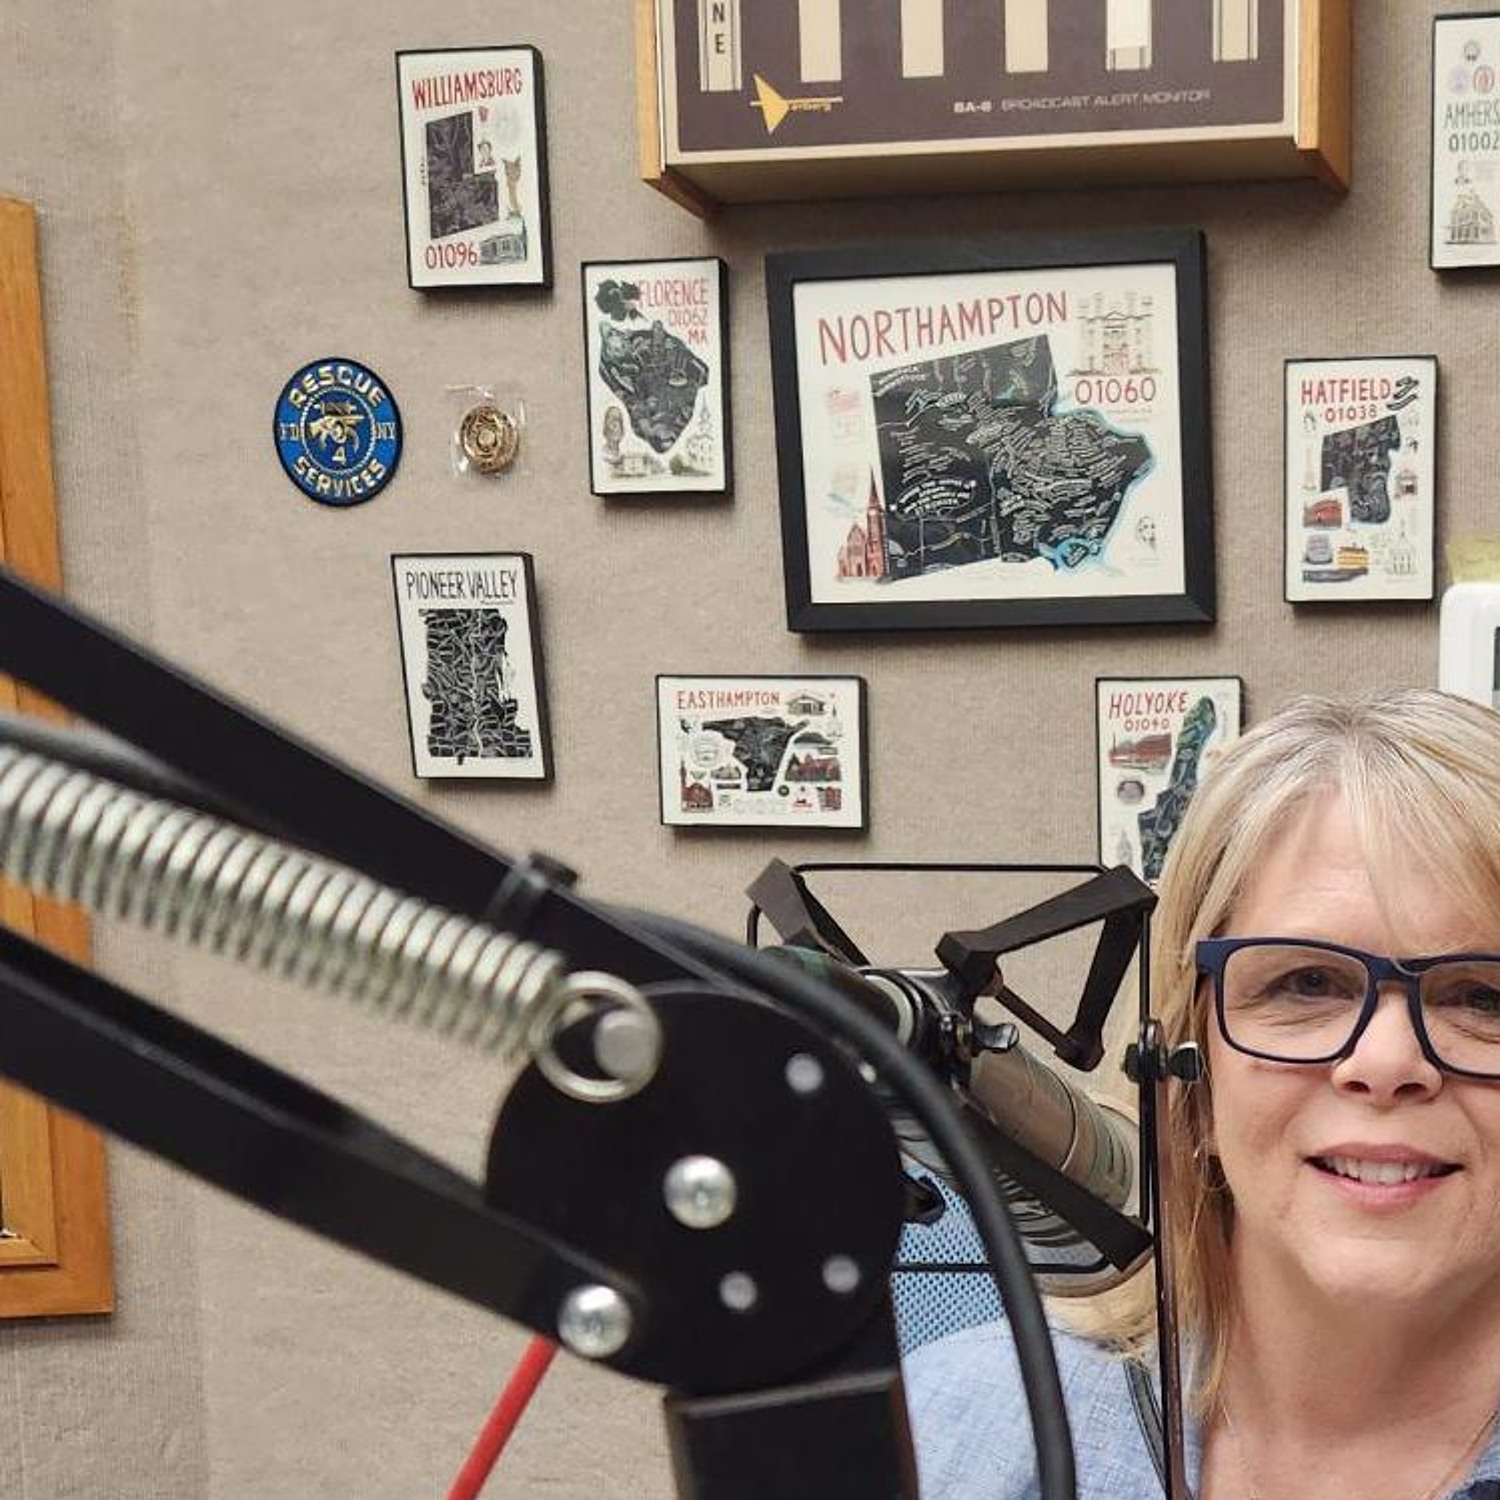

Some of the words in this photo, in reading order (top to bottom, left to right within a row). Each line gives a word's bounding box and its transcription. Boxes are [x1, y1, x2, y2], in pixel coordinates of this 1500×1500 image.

[412, 68, 523, 111] WILLIAMSBURG
[1094, 93, 1139, 107] ALERT
[1143, 88, 1210, 105] MONITOR
[1448, 132, 1500, 152] 01002
[425, 242, 478, 269] 01096
[638, 278, 709, 308] FLORENCE
[688, 329, 708, 345] MA
[817, 290, 1069, 366] NORTHAMPTON
[289, 365, 386, 408] RESCUE
[1075, 378, 1156, 405] 01060
[1301, 378, 1391, 405] HATFIELD
[1325, 404, 1378, 423] 01038
[293, 457, 386, 497] SERVICES
[406, 571, 466, 600] PIONEER
[468, 570, 518, 599] VALLEY
[677, 688, 781, 710] EASTHAMPTON
[1109, 692, 1190, 719] HOLYOKE
[1124, 718, 1171, 732] 01040
